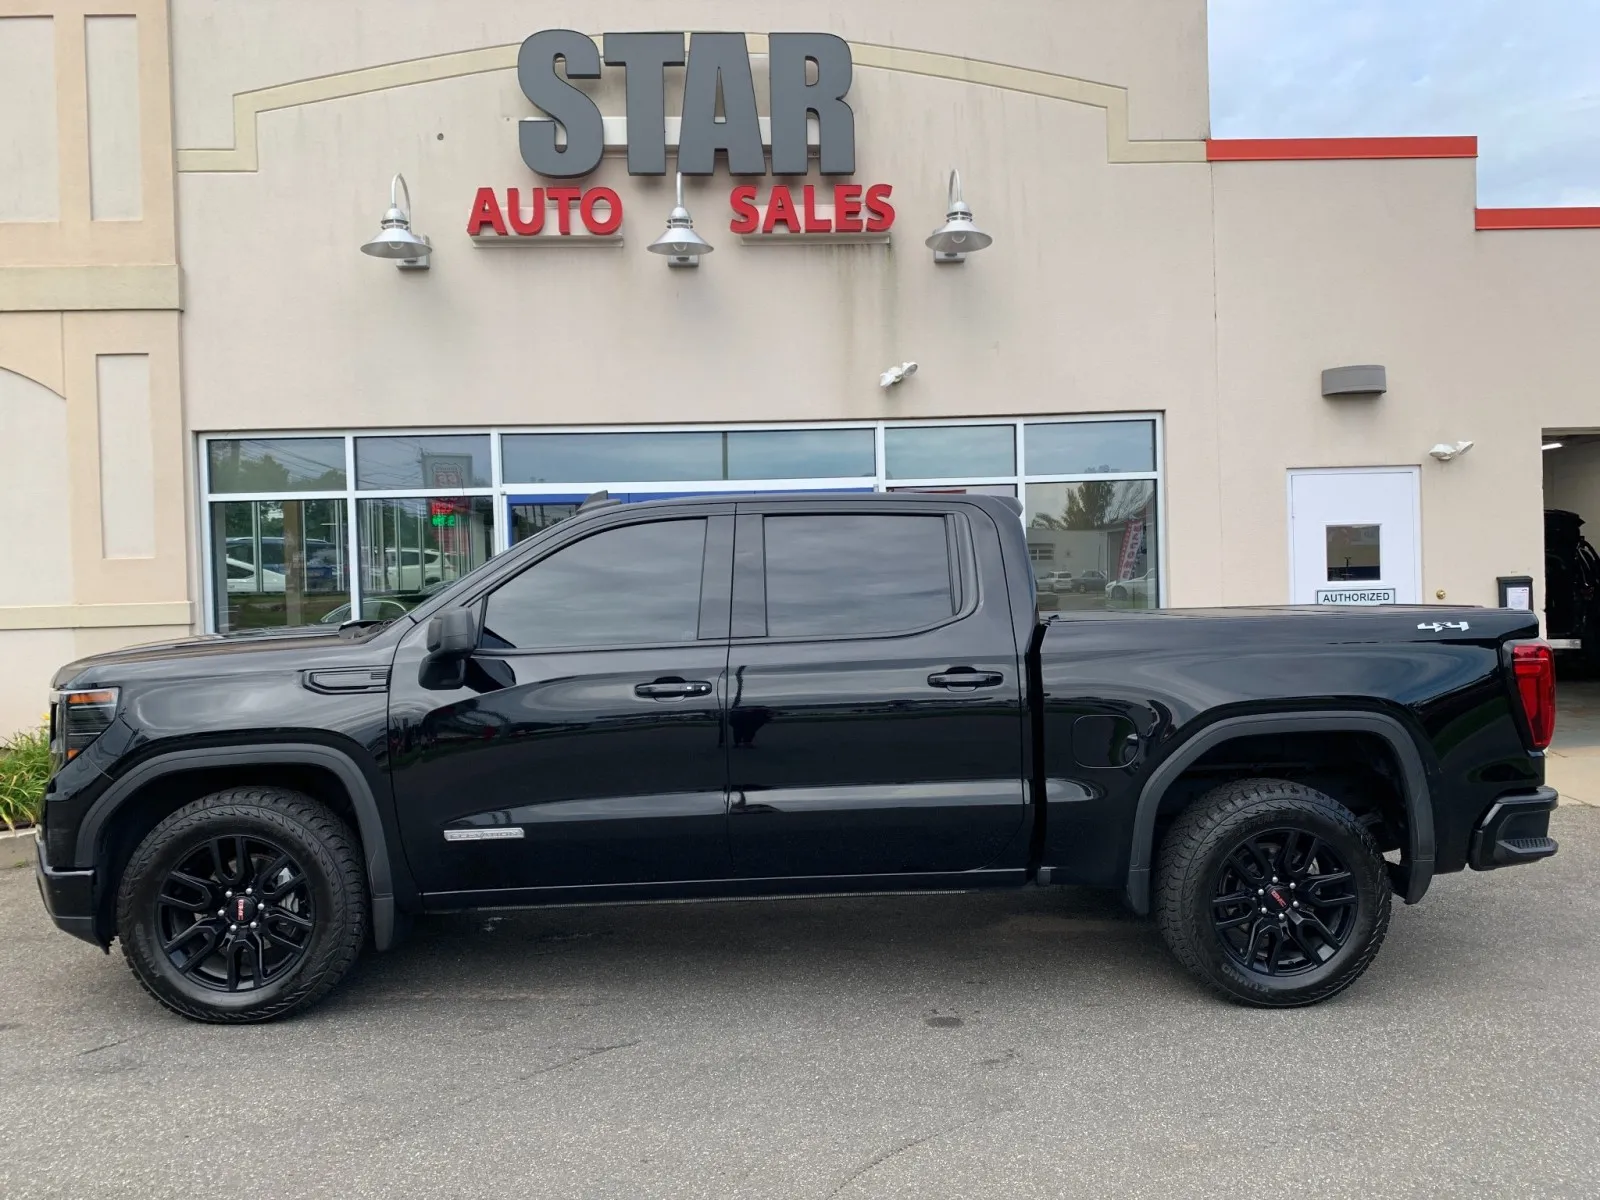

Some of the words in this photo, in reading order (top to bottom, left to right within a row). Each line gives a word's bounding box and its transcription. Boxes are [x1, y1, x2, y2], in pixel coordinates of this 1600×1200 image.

[518, 29, 855, 178] STAR
[467, 187, 623, 236] AUTO
[730, 184, 896, 234] SALES
[1323, 592, 1390, 602] AUTHORIZED
[1270, 889, 1287, 908] GMC
